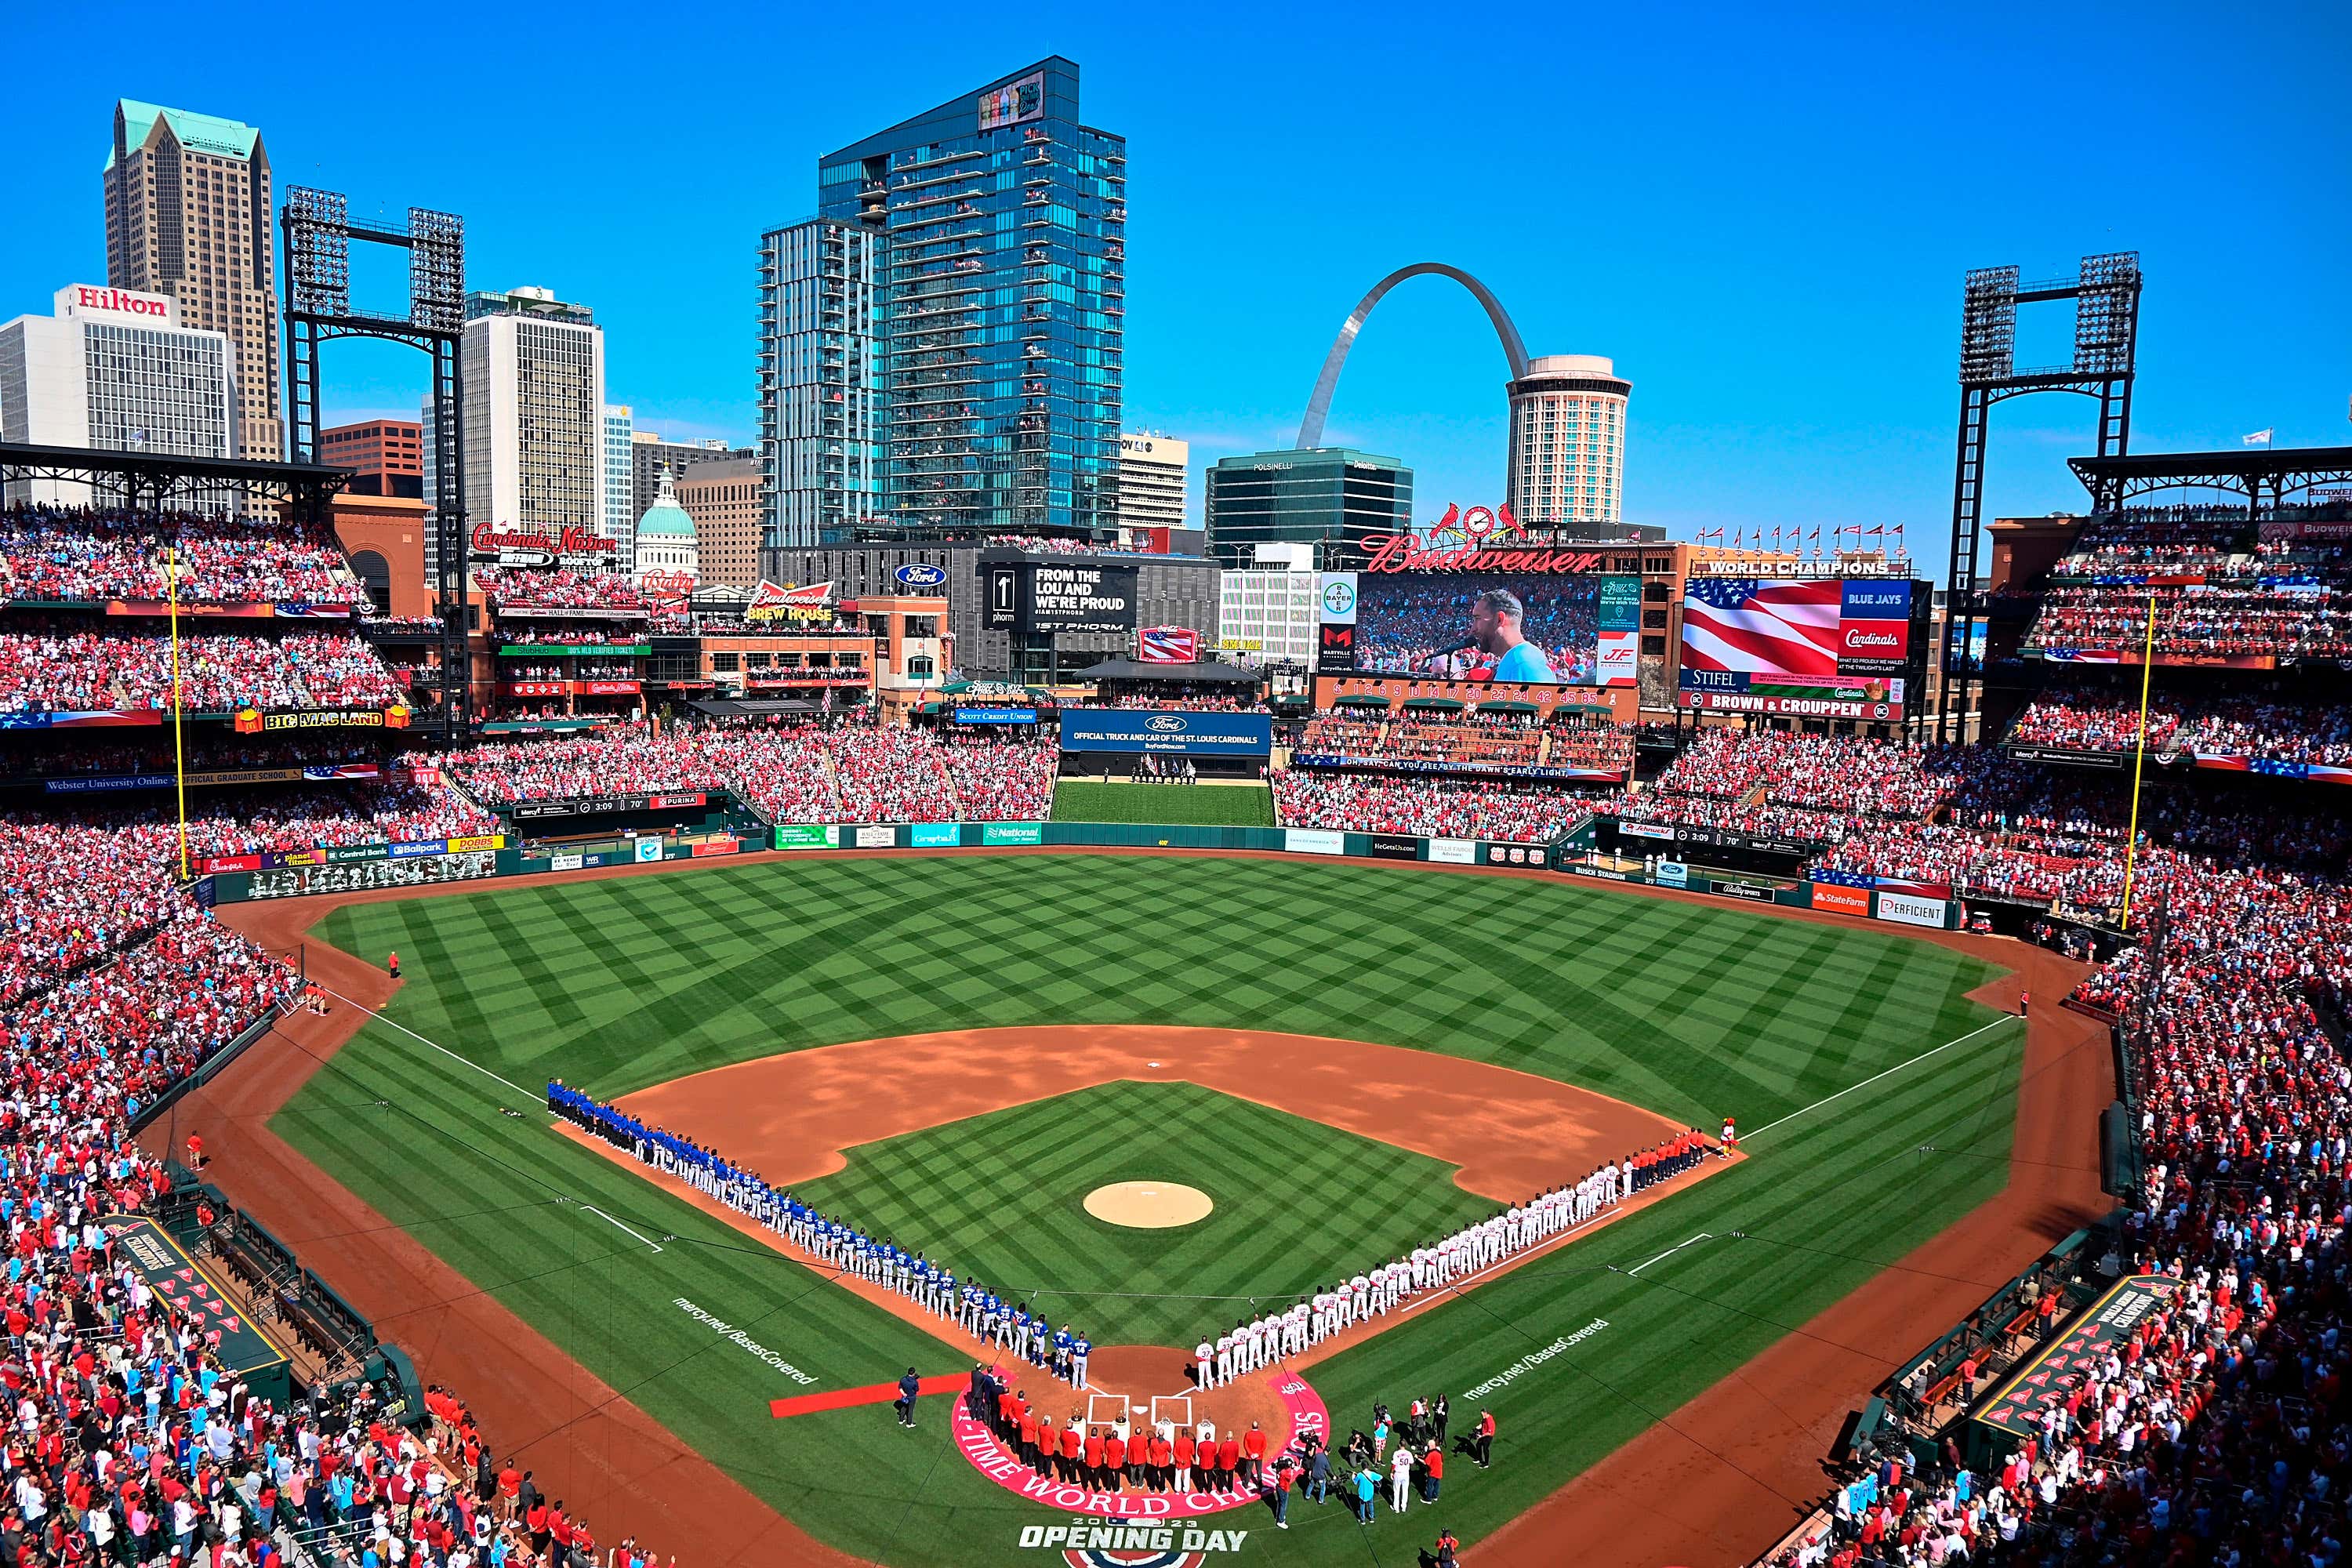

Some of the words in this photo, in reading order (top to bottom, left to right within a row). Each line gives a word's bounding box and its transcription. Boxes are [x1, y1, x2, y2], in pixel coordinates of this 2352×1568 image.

[78, 287, 166, 317] Hilton
[1254, 462, 1292, 470] POLSINELLI
[473, 522, 553, 551] Cardinals
[552, 526, 616, 554] Nation
[1360, 534, 1601, 572] Budweiser
[1709, 562, 1772, 574] WORLD
[1777, 562, 1889, 574] CHAMPIONS
[906, 566, 937, 583] Ford
[1036, 568, 1075, 582] FROM
[1076, 570, 1101, 583] THE
[642, 568, 695, 594] Bally
[1036, 583, 1062, 595] LOU
[1064, 583, 1092, 596] AND
[747, 589, 833, 604] Budweiser
[1848, 594, 1873, 604] BLUE
[1875, 595, 1901, 604] JAYS
[1035, 596, 1078, 609] WE'RE
[1080, 597, 1125, 610] PROUD
[747, 608, 785, 620] BREW
[789, 608, 833, 621] HOUSE
[993, 612, 1014, 623] phorm
[1846, 629, 1898, 648] Cardinals
[1221, 640, 1262, 650] SMOKE
[1693, 669, 1737, 686] STIFEL
[1353, 684, 1359, 695] 1
[1364, 684, 1372, 695] 2
[1378, 684, 1386, 695] 6
[1393, 685, 1401, 696] 9
[1408, 686, 1420, 697] 10
[1427, 687, 1439, 698] 14
[1446, 688, 1459, 699] 17
[1466, 688, 1481, 700] 20
[1491, 688, 1506, 701] 23
[1512, 689, 1528, 702] 24
[1835, 687, 1865, 698] Cardinals
[1536, 691, 1552, 703] 42
[1559, 691, 1577, 704] 45
[1581, 692, 1597, 704] 85
[1711, 695, 1764, 710] BROWN
[1768, 701, 1777, 711] &
[1780, 699, 1863, 717] CROUPPEN
[1876, 706, 1887, 715] BC
[265, 713, 297, 730] BIG
[300, 712, 339, 728] MAC
[340, 711, 383, 727] LAND
[1152, 717, 1181, 730] Ford
[1073, 732, 1105, 741] OFFICIAL
[1218, 735, 1258, 744] CARDINALS
[2016, 750, 2034, 760] Mercy
[1346, 758, 1360, 767] OH,
[1363, 759, 1381, 768] SAY,
[1403, 760, 1421, 769] YOU
[1457, 764, 1473, 772] THE
[1475, 765, 1508, 774] DAWN'S
[1511, 767, 1537, 775] EARLY
[1541, 768, 1568, 778] LIGHT,
[217, 772, 256, 782] GRADUATE
[259, 771, 288, 781] SCHOOL
[48, 779, 85, 790] Webster
[89, 779, 135, 789] University
[138, 776, 169, 786] Online
[595, 802, 612, 811] 3:09
[667, 797, 695, 806] PURINA
[521, 808, 538, 817] Mercy
[998, 827, 1039, 838] National
[1635, 825, 1670, 835] Schnucks
[459, 837, 494, 847] DOBBS
[635, 836, 662, 844] CarShield
[1692, 833, 1709, 842] 3:09
[1726, 837, 1740, 845] 70°
[404, 844, 442, 855] Ballpark
[1374, 842, 1415, 852] HeGetsUs.com
[1431, 844, 1452, 853] WELLS
[1752, 841, 1768, 850] Mercy
[284, 851, 310, 862] planet
[339, 849, 367, 859] Central
[368, 848, 387, 857] Bank
[1493, 851, 1503, 860] 66
[288, 857, 316, 866] fitness
[1575, 866, 1596, 877] BUSCH
[1597, 869, 1626, 880] STADIUM
[1664, 865, 1680, 874] Ford
[1723, 884, 1744, 895] Bally
[1880, 898, 1941, 920] PERFICIENT
[2097, 1302, 2122, 1323] WORLD
[2114, 1290, 2139, 1308] SERIES
[2111, 1294, 2155, 1328] CHAMPIONS
[672, 1294, 820, 1386] mercy.net/BasesCovered
[1462, 1317, 1610, 1401] mercy.net/BasesCovered
[1022, 1475, 1171, 1515] WORLD
[1018, 1526, 1173, 1550] OPENING
[1181, 1529, 1248, 1552] DAY
